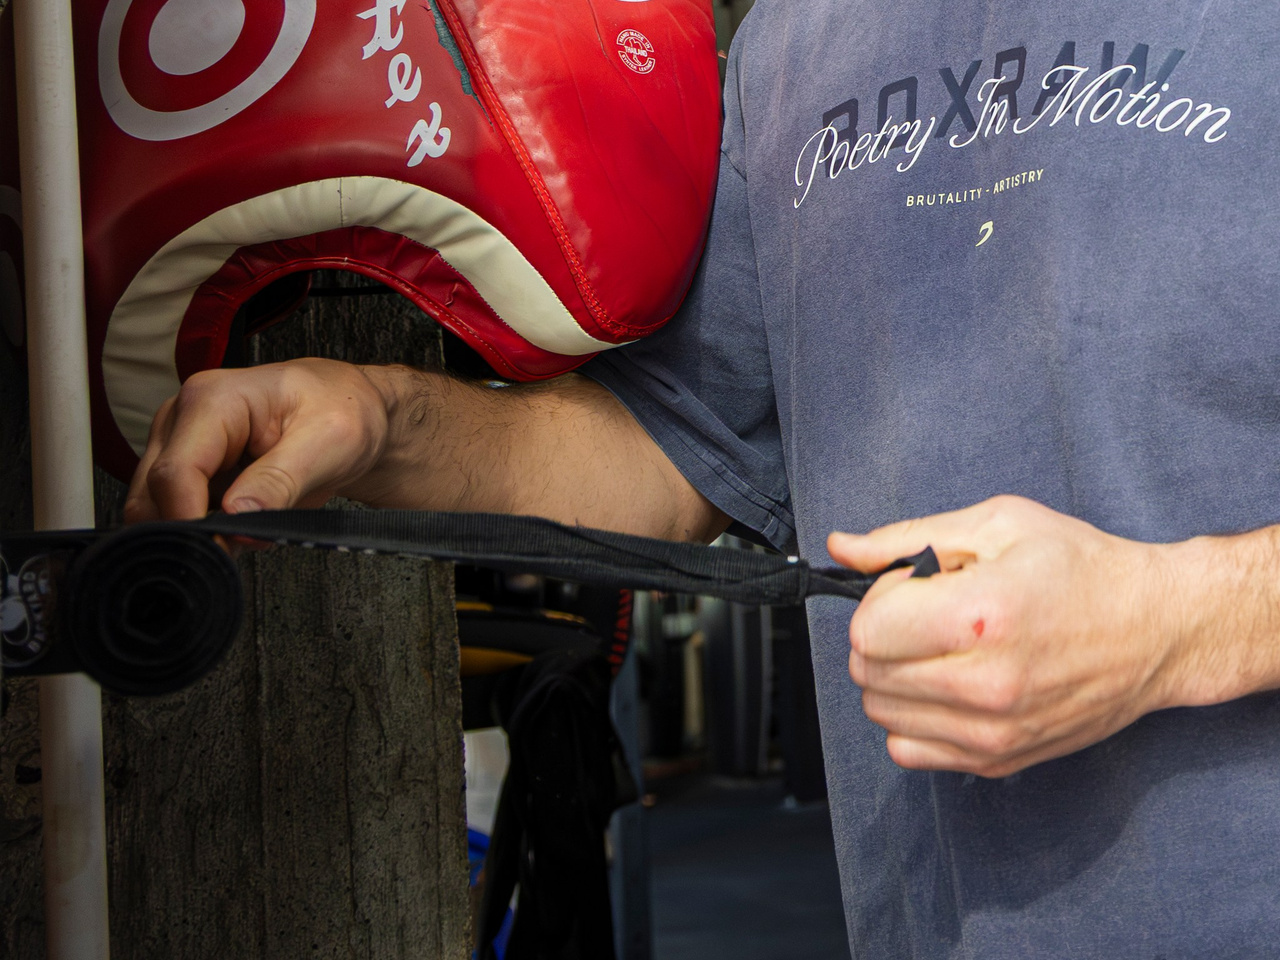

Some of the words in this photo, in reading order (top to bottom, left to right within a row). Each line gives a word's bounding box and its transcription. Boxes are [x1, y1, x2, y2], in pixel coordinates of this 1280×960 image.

[624, 45, 648, 57] THAILAND
[793, 115, 936, 210] Poetry
[949, 76, 1009, 148] In
[1015, 64, 1232, 144] Motion
[822, 40, 1186, 178] BOXRAW
[906, 187, 983, 207] BRUTALITY
[993, 168, 1044, 195] ARTISTRY
